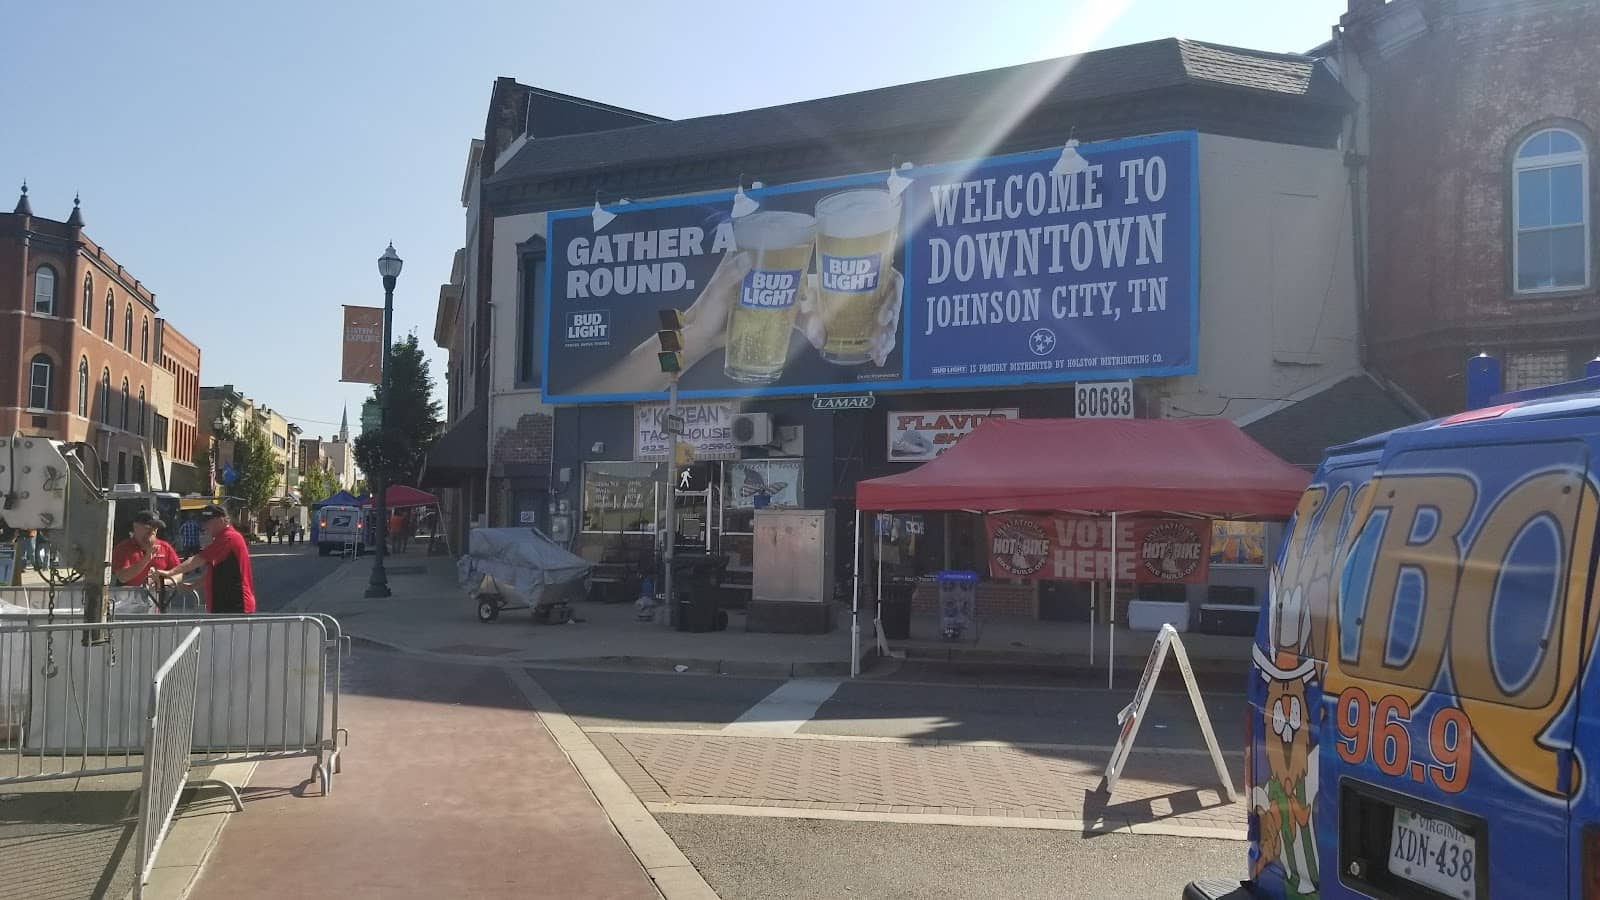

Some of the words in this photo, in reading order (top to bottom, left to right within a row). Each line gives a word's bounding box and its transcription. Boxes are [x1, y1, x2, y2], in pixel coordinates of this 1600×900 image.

[931, 164, 1103, 227] WELCOME
[1120, 156, 1167, 205] TO
[567, 226, 703, 266] GATHER
[711, 224, 737, 254] A
[928, 213, 1166, 284] DOWNTOWN
[823, 271, 878, 289] LIGHT
[828, 260, 872, 276] BUD
[566, 262, 694, 299] ROUND.
[752, 272, 794, 292] BUD
[743, 287, 797, 306] LIGHT
[926, 288, 1041, 336] JOHNSON
[1052, 281, 1120, 321] CITY,
[1128, 277, 1168, 312] TN
[568, 324, 607, 338] LIGHT
[574, 313, 602, 326] BUD
[970, 364, 976, 373] IS
[979, 363, 1008, 373] PROUDLY
[1009, 360, 1053, 371] DISTRIBUTED
[1056, 359, 1064, 369] BY
[1067, 357, 1097, 368] HOLSTON
[1100, 354, 1149, 366] DISTRIBUTING
[817, 397, 868, 408] LAMAR
[1078, 386, 1131, 418] 80683
[680, 428, 730, 440] HOUSE
[1054, 519, 1136, 548] VOTE
[993, 538, 1016, 554] HOT
[1024, 539, 1050, 556] BIKE
[1142, 542, 1166, 559] HOT
[1174, 543, 1202, 560] BIKE
[1054, 550, 1137, 579] HERE
[1335, 686, 1473, 794] 96.9
[1418, 816, 1466, 844] VIRGINIA
[1394, 826, 1473, 882] XDN-438
